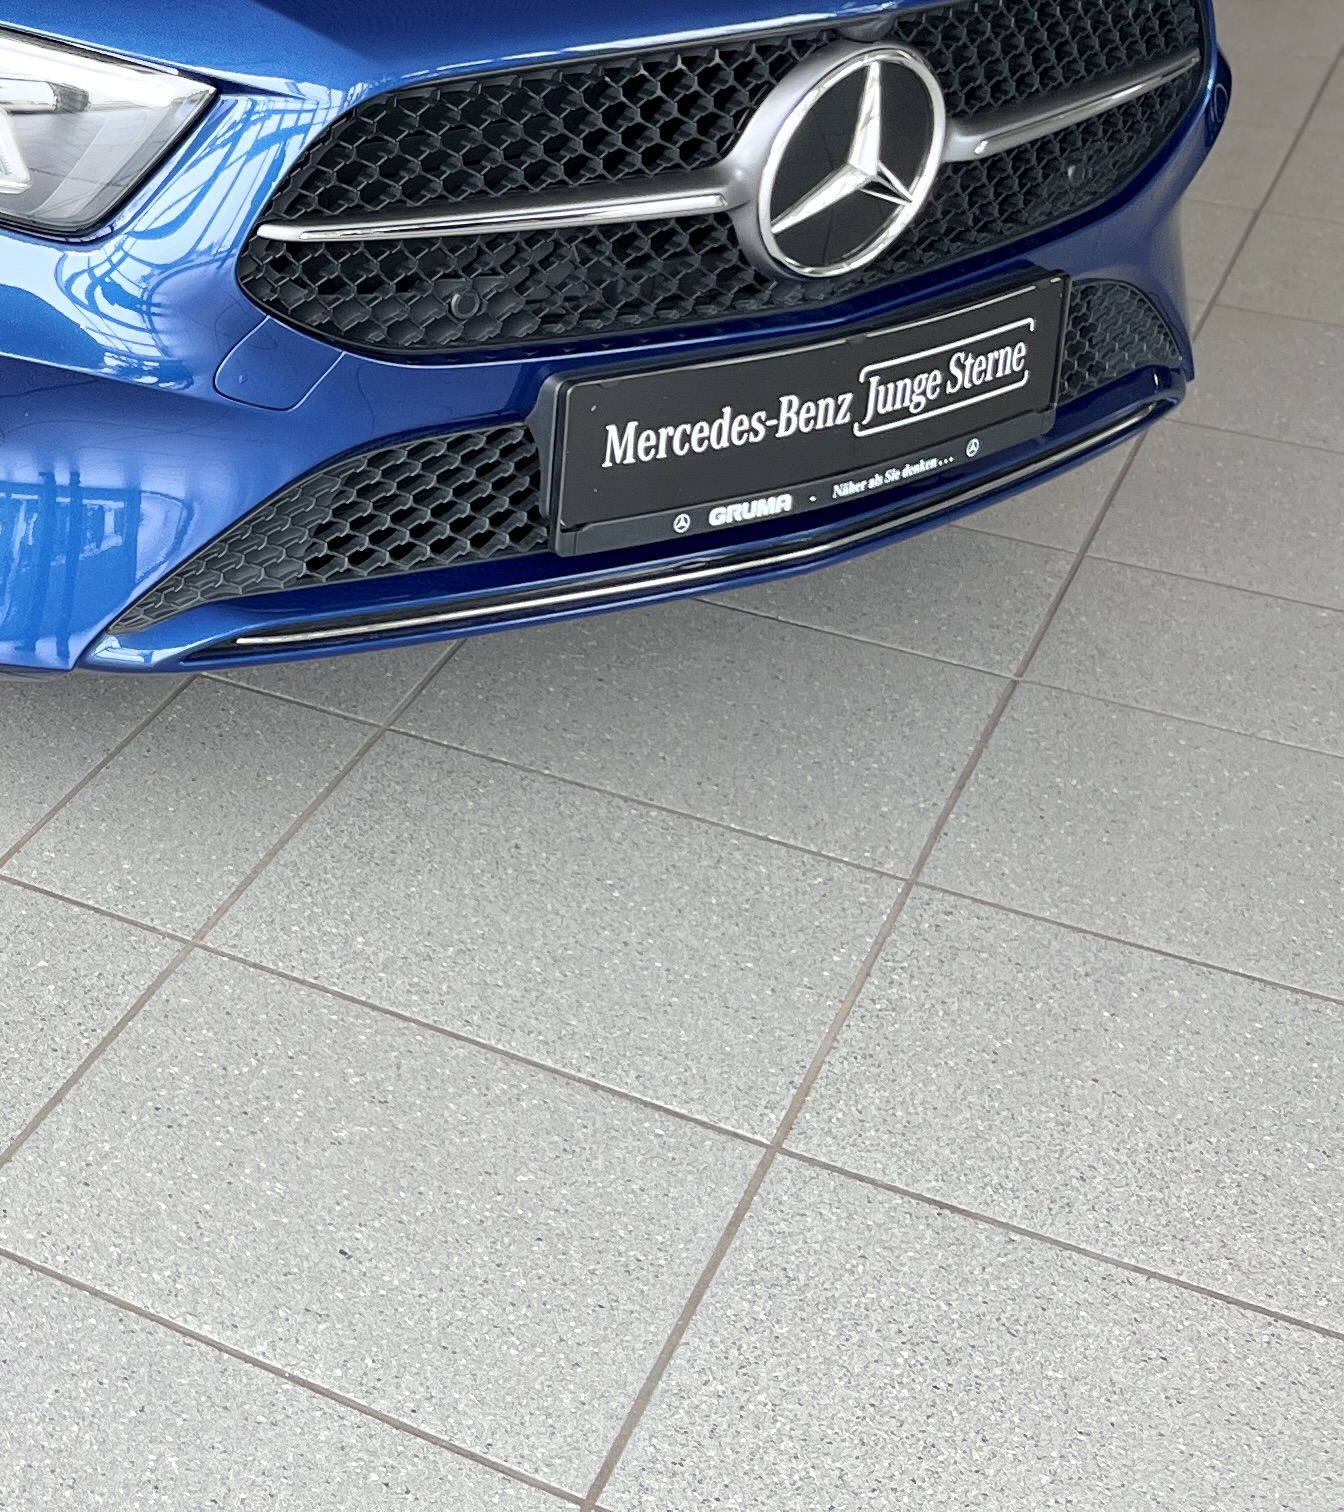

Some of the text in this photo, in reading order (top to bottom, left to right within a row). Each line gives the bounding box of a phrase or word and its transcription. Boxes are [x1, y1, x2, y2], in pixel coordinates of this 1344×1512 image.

[601, 341, 1028, 468] Mercedes-Benz Junge Sterne
[831, 480, 868, 500] Näher
[868, 474, 884, 490] als
[884, 468, 901, 485] Sie
[708, 493, 793, 526] GRUMA
